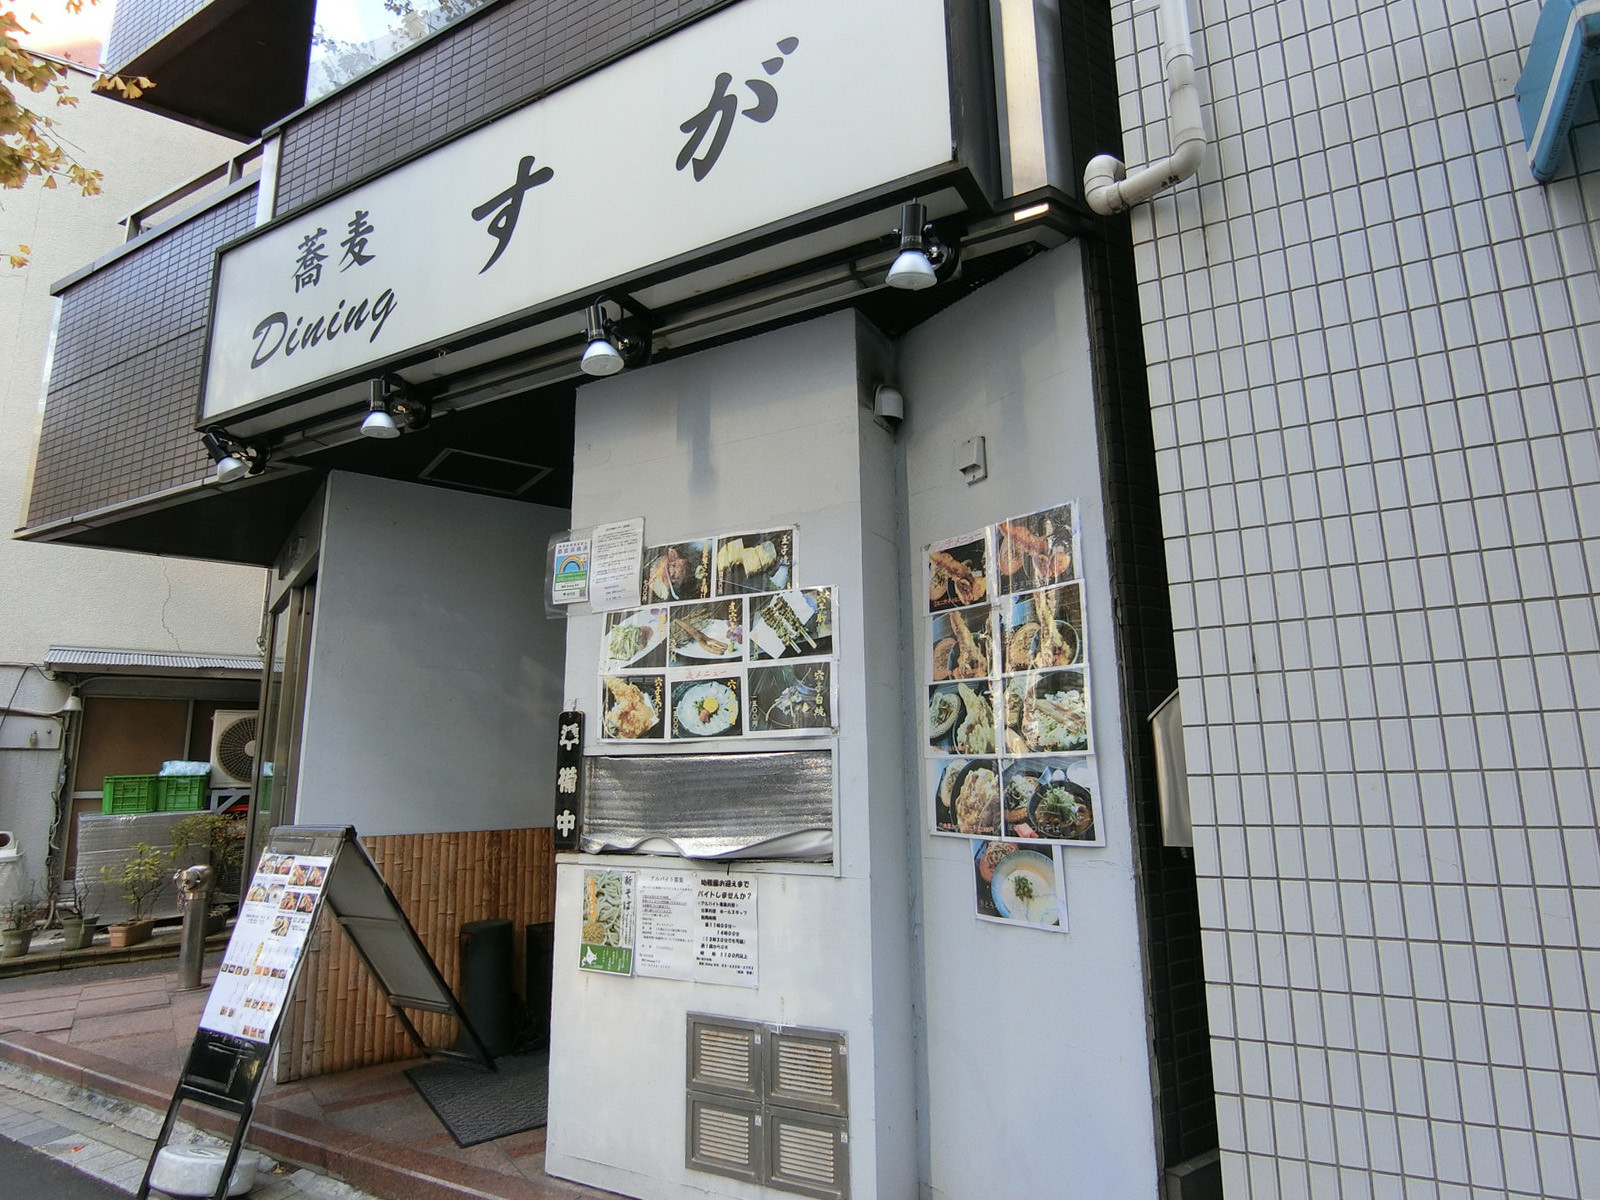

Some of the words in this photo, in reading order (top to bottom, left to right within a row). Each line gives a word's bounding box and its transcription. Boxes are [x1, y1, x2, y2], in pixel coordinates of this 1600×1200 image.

[291, 210, 376, 294] 蕎麦
[250, 288, 398, 369] Dining
[556, 722, 580, 838] 準備中
[622, 875, 633, 911] 新そば
[700, 879, 750, 889] 幼稚園お迎えまで
